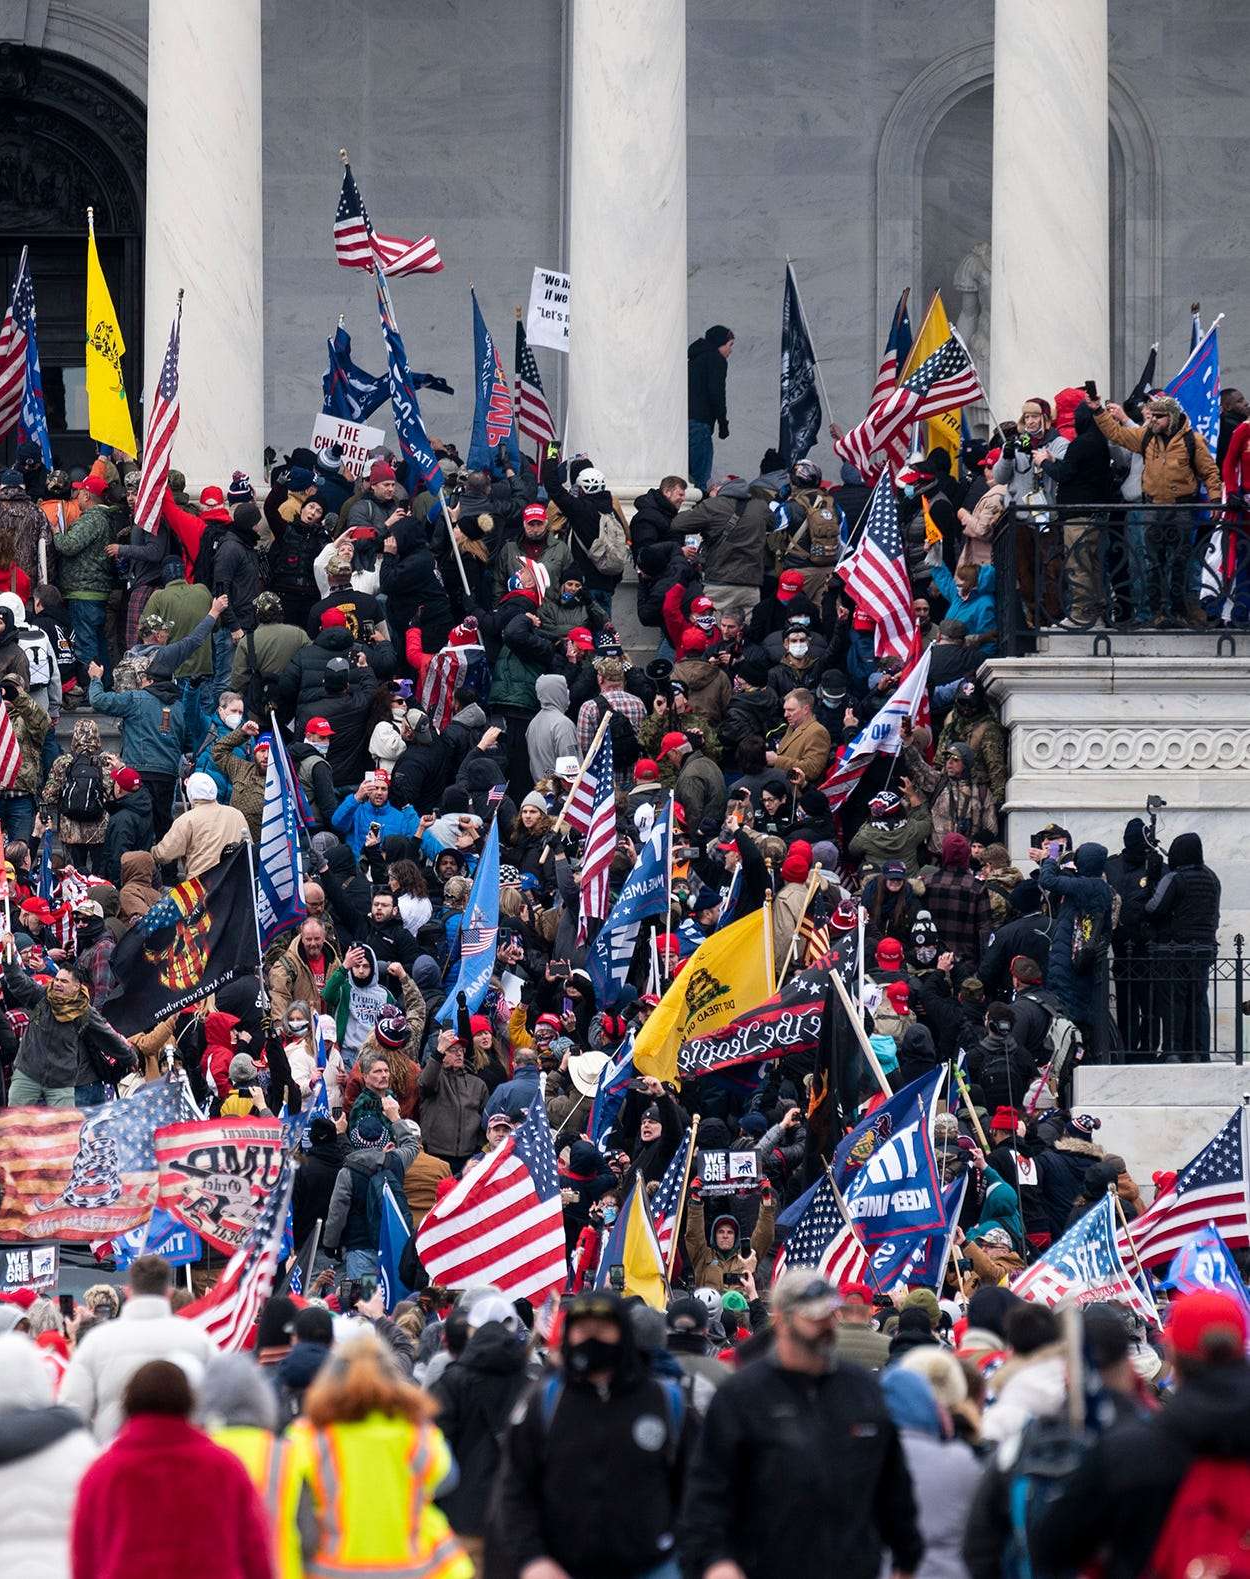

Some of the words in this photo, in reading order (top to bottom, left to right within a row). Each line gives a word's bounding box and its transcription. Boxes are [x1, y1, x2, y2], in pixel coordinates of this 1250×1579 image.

[337, 423, 360, 443] THE
[314, 435, 371, 463] CHIDREN
[703, 1152, 726, 1164] WE
[704, 1163, 726, 1173] ARE
[704, 1171, 726, 1182] ONE
[5, 1251, 30, 1265] WE
[6, 1264, 30, 1275] ARE
[6, 1272, 30, 1283] ONE
